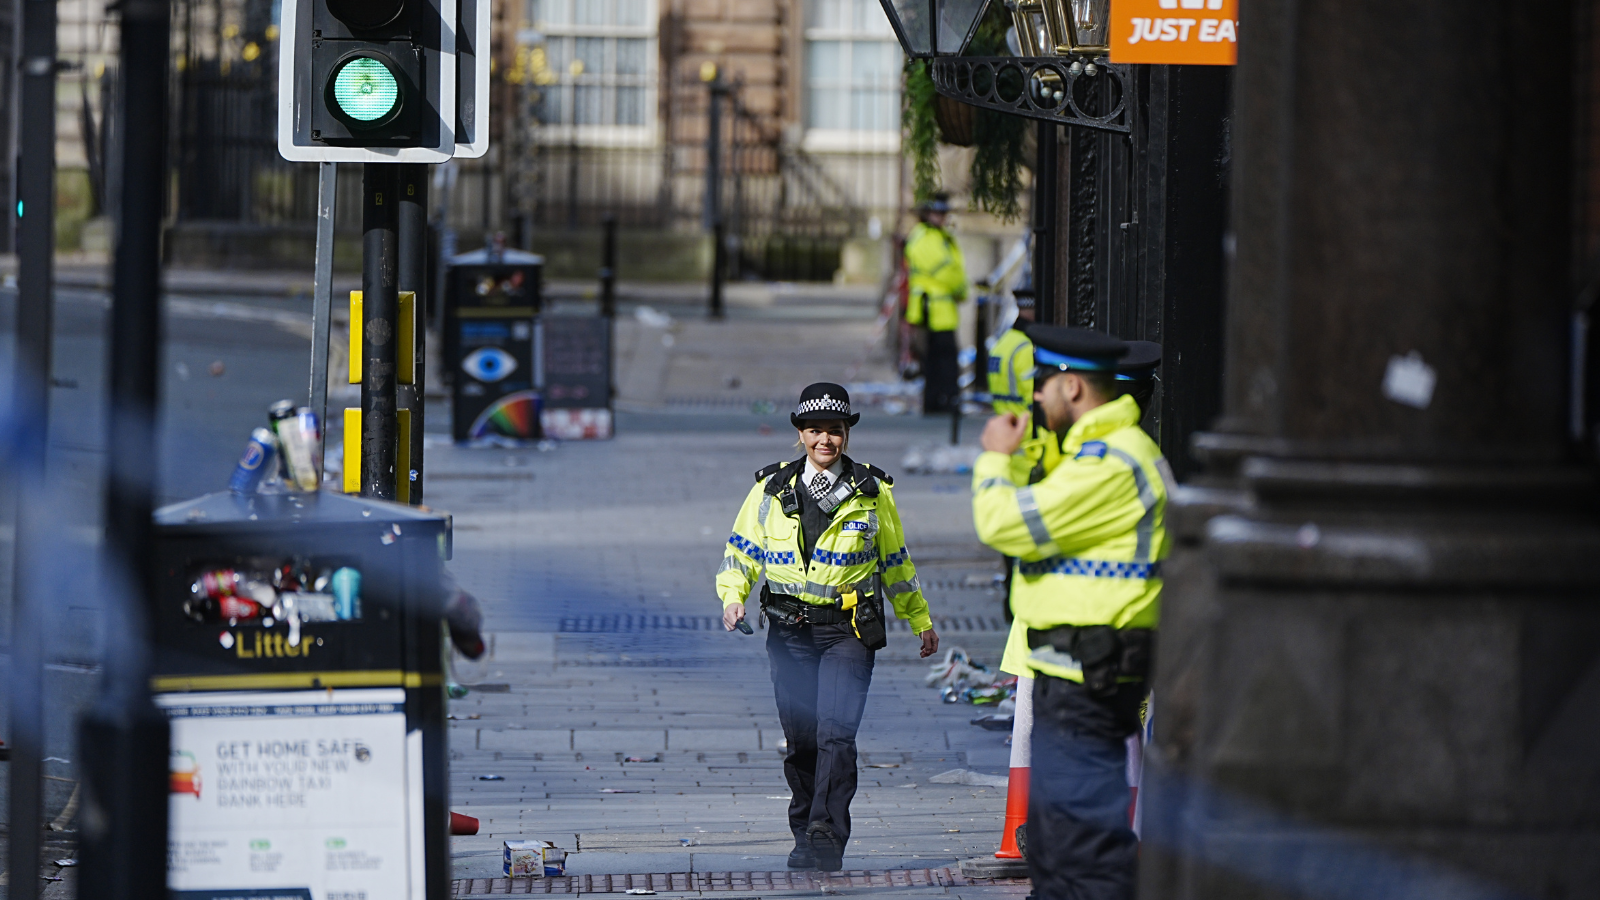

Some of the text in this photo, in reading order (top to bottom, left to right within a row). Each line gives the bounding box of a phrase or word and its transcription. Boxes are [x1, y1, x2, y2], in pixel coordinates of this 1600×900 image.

[1127, 17, 1239, 45] JUST EA
[843, 522, 867, 530] POLICE
[236, 631, 315, 659] Litter
[216, 740, 252, 760] GET
[257, 739, 311, 759] HOME
[216, 761, 258, 775] WITH
[311, 759, 350, 774] NEW
